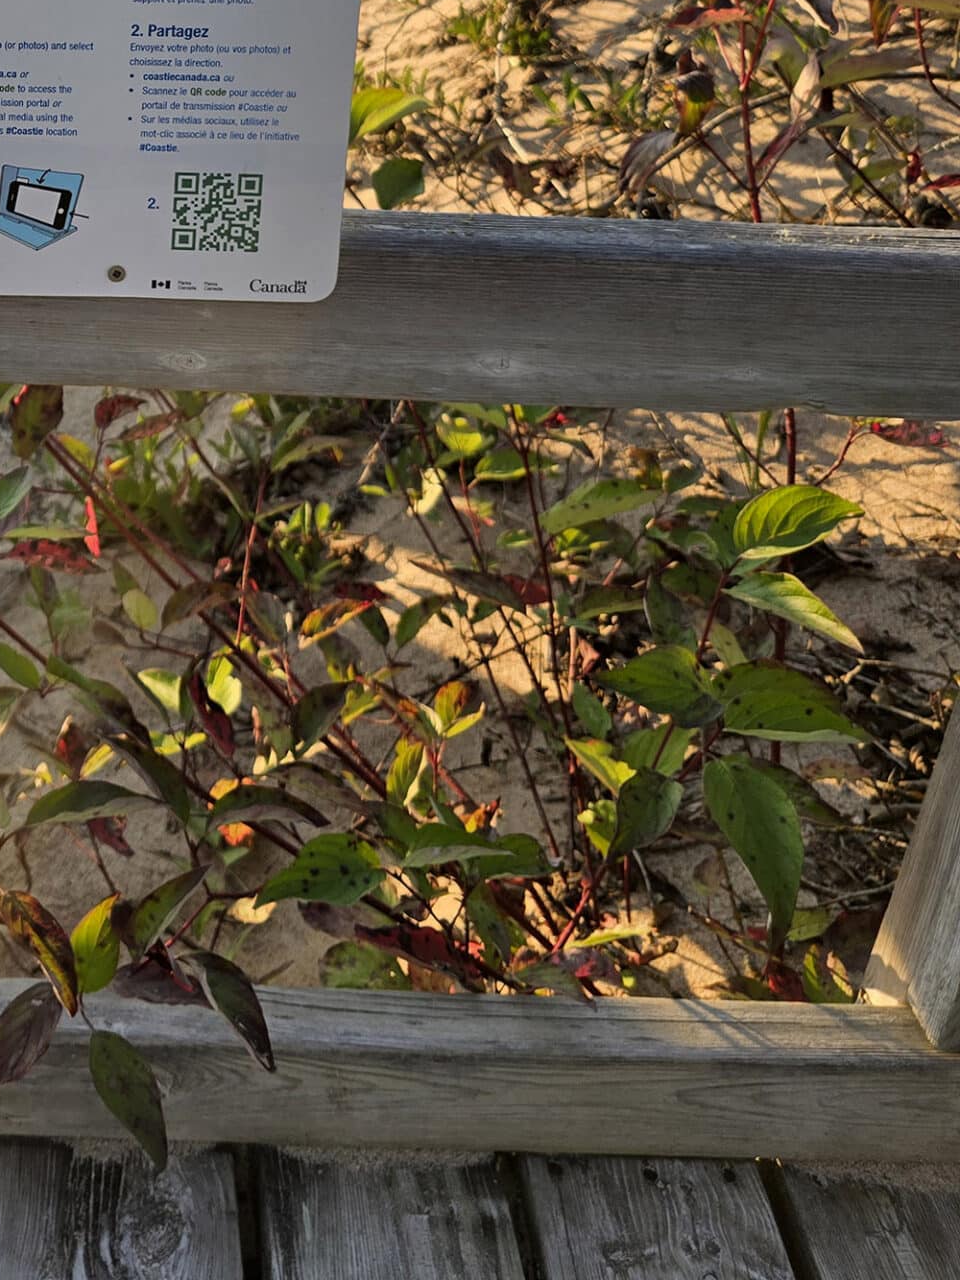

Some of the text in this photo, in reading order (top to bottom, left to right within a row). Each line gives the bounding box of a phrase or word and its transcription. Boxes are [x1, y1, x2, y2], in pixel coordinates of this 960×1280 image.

[131, 23, 208, 40] 2. Partagez
[4, 40, 16, 50] (or
[18, 40, 48, 51] photos)
[51, 40, 66, 49] and
[69, 41, 93, 49] select
[130, 42, 164, 53] Envoyez
[166, 43, 187, 52] votre
[190, 43, 214, 54] photo
[216, 43, 229, 53] (ou
[249, 44, 280, 55] photos)
[283, 45, 291, 53] et
[129, 57, 222, 66] choisissez la direction.
[143, 71, 220, 81] coastiecanada.ca
[17, 84, 25, 92] to
[59, 84, 72, 93] the
[142, 86, 177, 95] Scannez
[179, 86, 187, 95] le
[190, 86, 202, 95] QR
[204, 87, 227, 96] code
[228, 89, 247, 98] pour
[25, 98, 49, 108] portal
[142, 100, 167, 111] portail
[169, 100, 180, 109] de
[183, 101, 235, 110] transmission
[238, 102, 273, 111] #Coastie
[8, 112, 33, 121] media
[35, 112, 57, 123] using
[60, 112, 73, 121] the
[141, 114, 155, 123] Sur
[157, 114, 169, 123] les
[271, 117, 279, 126] le
[6, 125, 43, 135] #Coastie
[45, 126, 77, 135] location
[209, 130, 214, 138] à
[246, 131, 257, 139] de
[147, 197, 160, 209] 2.
[249, 279, 307, 294] Canada
